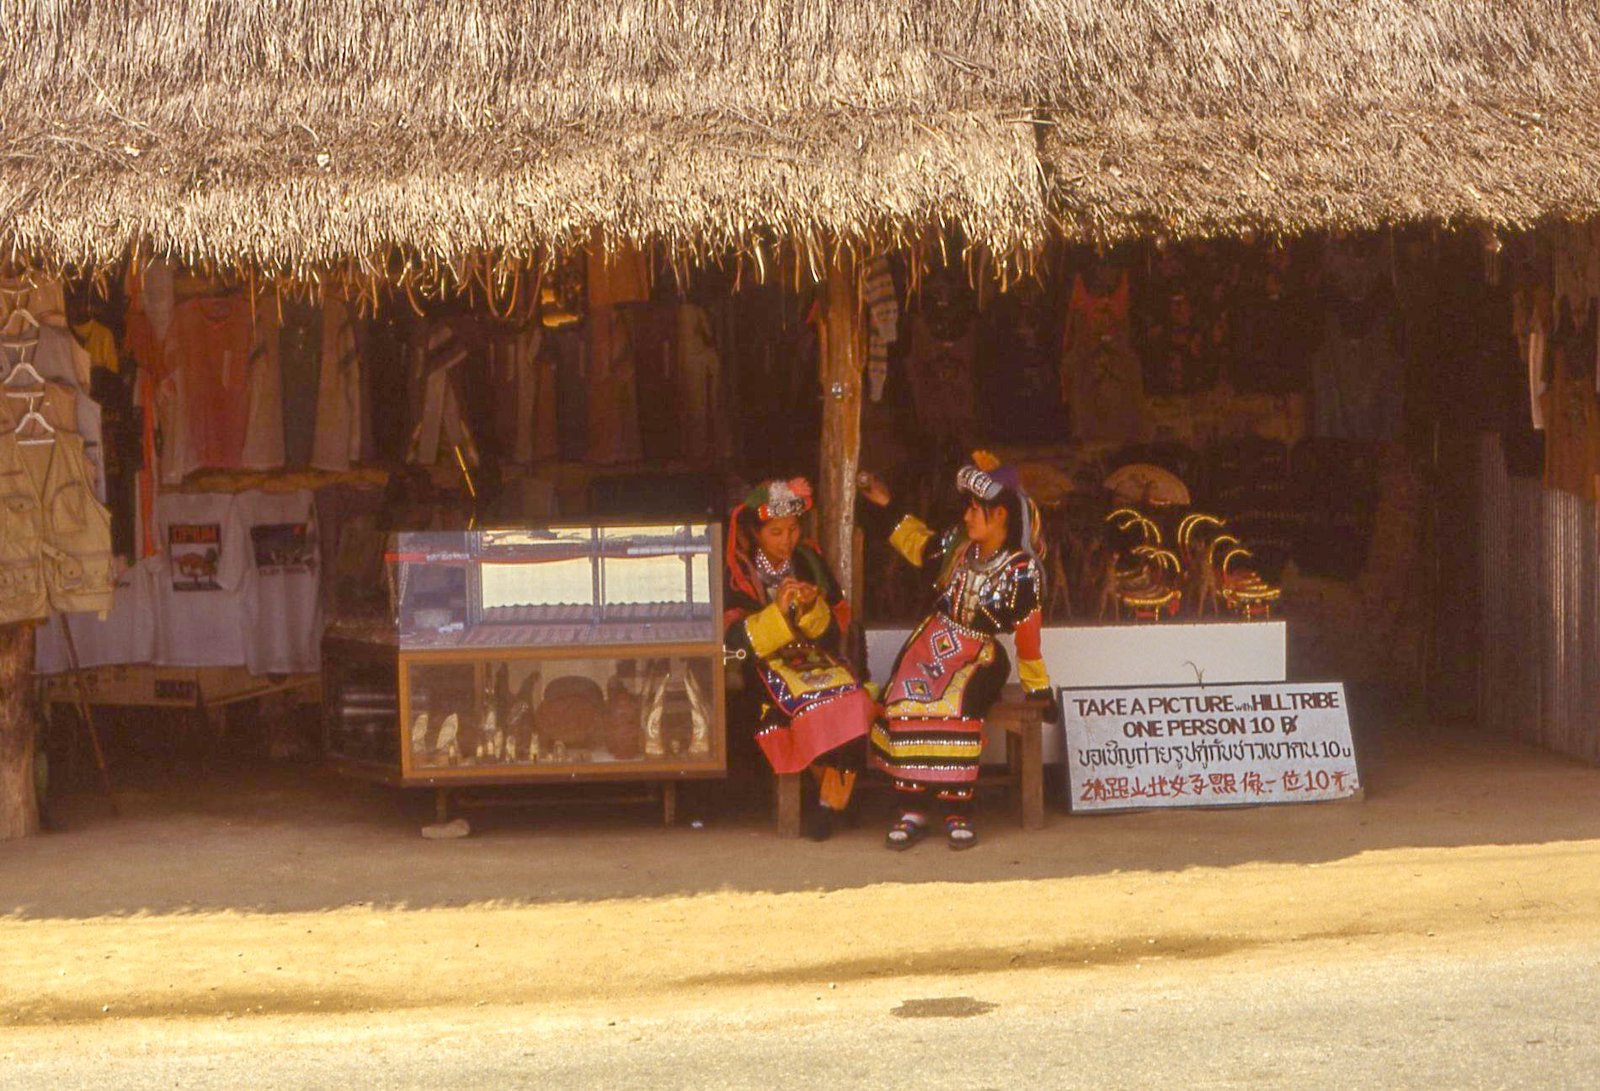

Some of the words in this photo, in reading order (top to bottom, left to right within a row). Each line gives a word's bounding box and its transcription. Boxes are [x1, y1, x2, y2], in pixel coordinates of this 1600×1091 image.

[1072, 698, 1127, 717] TAKE
[1130, 697, 1146, 715] A
[1148, 695, 1234, 715] PICTURE
[1235, 701, 1252, 712] with
[1123, 720, 1164, 738] ONE
[1167, 717, 1247, 737] PERSON
[1250, 717, 1275, 734] 10
